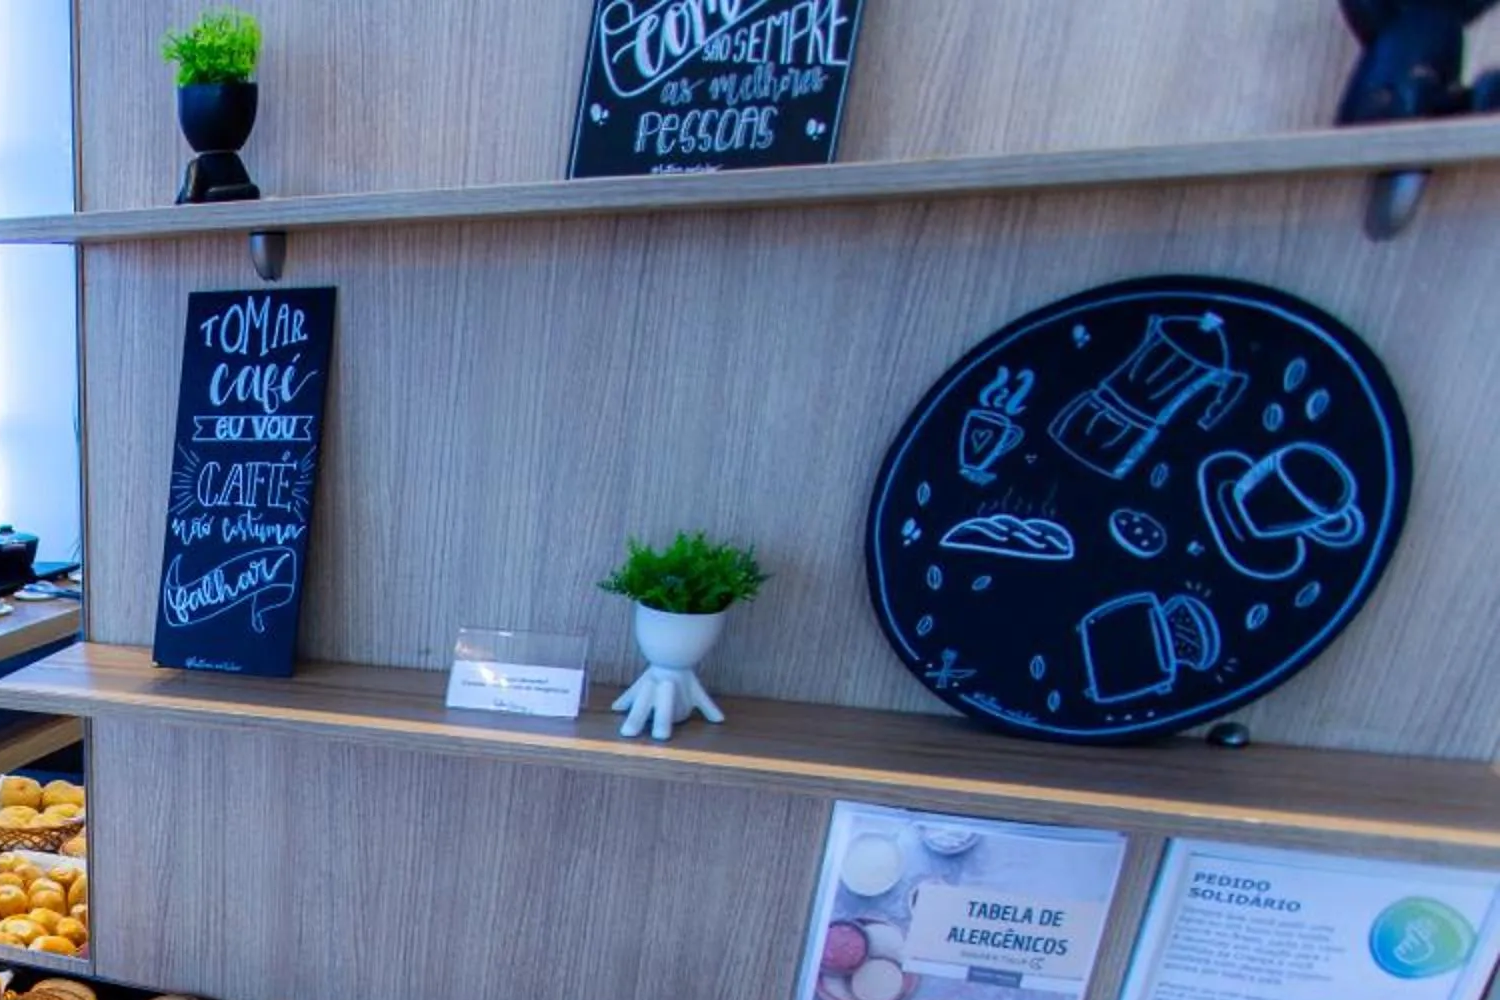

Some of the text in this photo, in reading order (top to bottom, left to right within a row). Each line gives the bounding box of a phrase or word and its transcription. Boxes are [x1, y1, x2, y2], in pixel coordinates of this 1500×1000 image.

[733, 0, 850, 65] SEMPRE
[201, 295, 308, 356] TOMAR
[210, 353, 318, 414] café
[251, 416, 298, 439] VOU
[197, 450, 298, 513] CAFÉ
[1193, 871, 1271, 892] PEDIDO
[967, 900, 1066, 927] TABELA DE
[1187, 887, 1301, 912] SOLIDÁRIO
[947, 926, 1069, 956] ALERGÊNICOS
